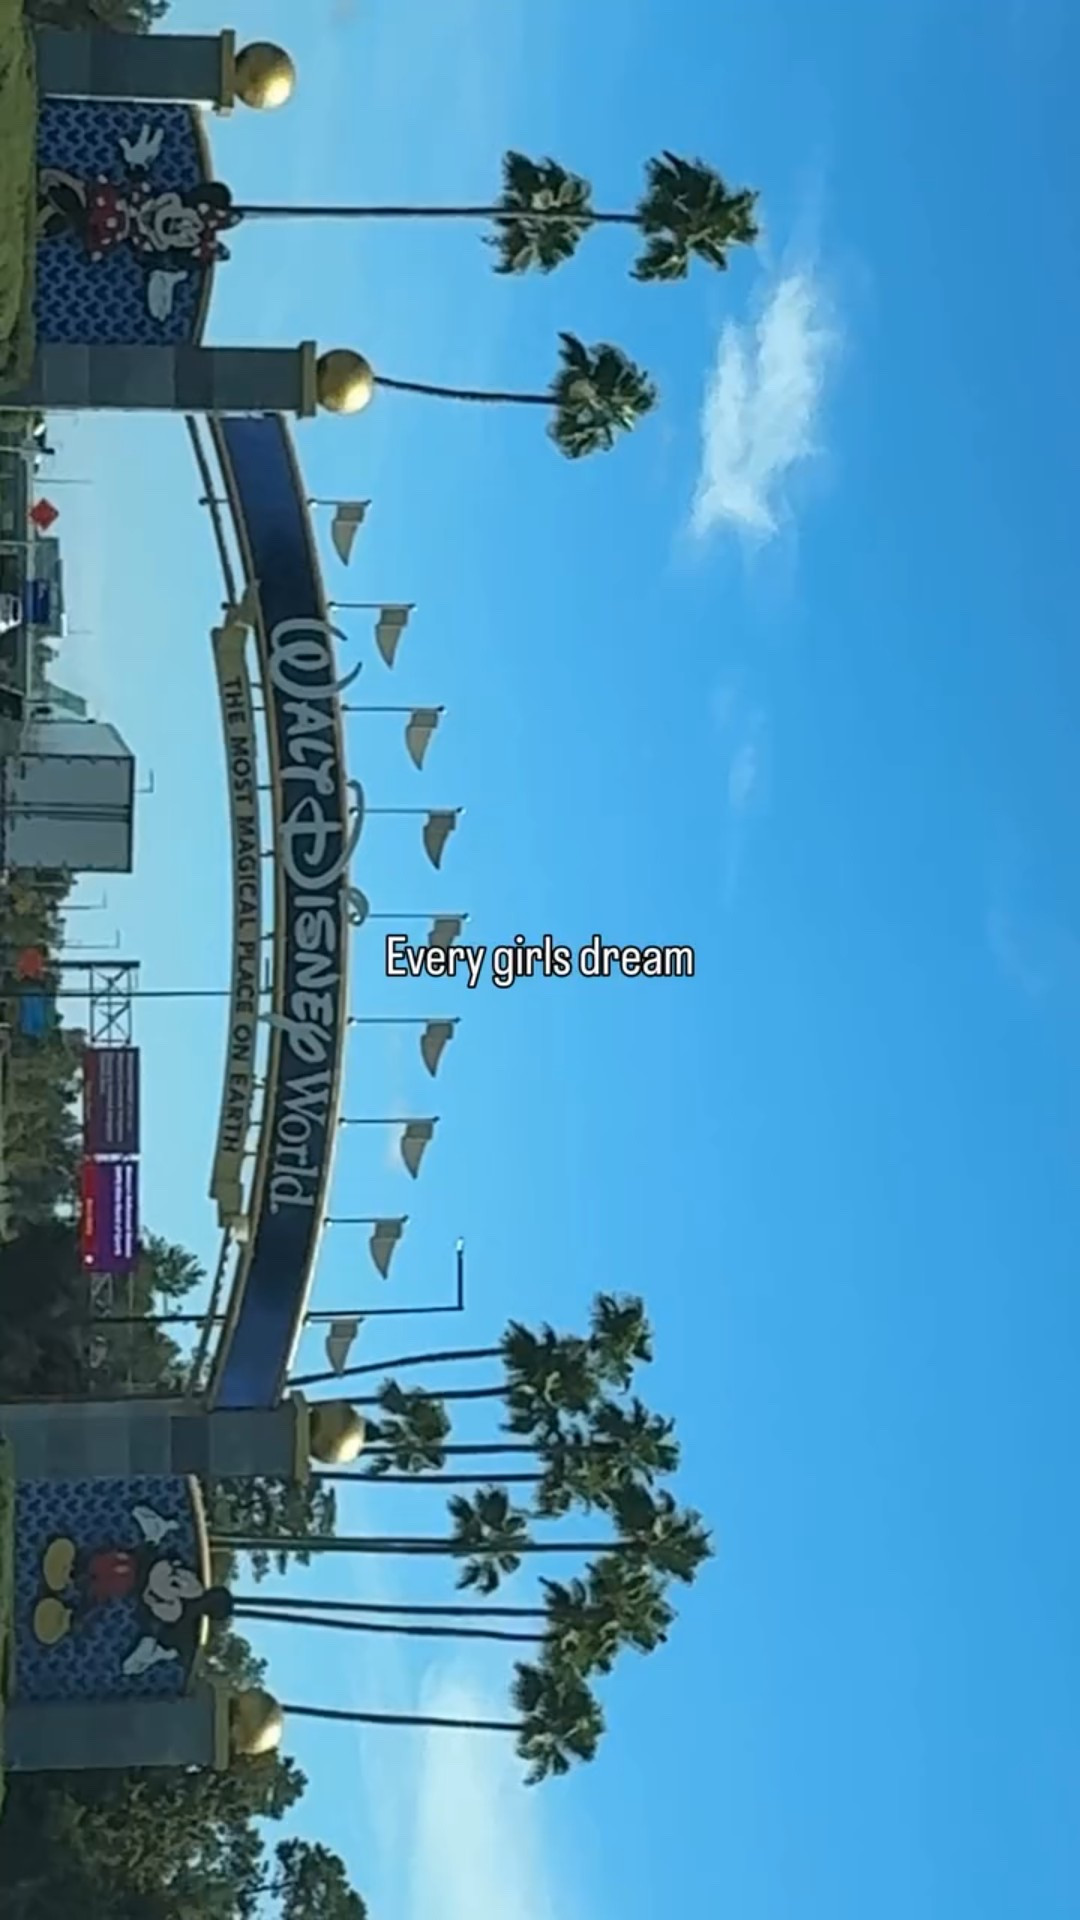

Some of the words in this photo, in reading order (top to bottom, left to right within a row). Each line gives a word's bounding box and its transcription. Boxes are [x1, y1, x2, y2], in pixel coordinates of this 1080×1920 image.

[224, 676, 247, 724] THE
[230, 737, 253, 802] MOST
[237, 815, 257, 928] MAGICAL
[235, 943, 256, 1014] PLACE
[231, 1028, 251, 1062] ON
[221, 1074, 250, 1153] EARTH
